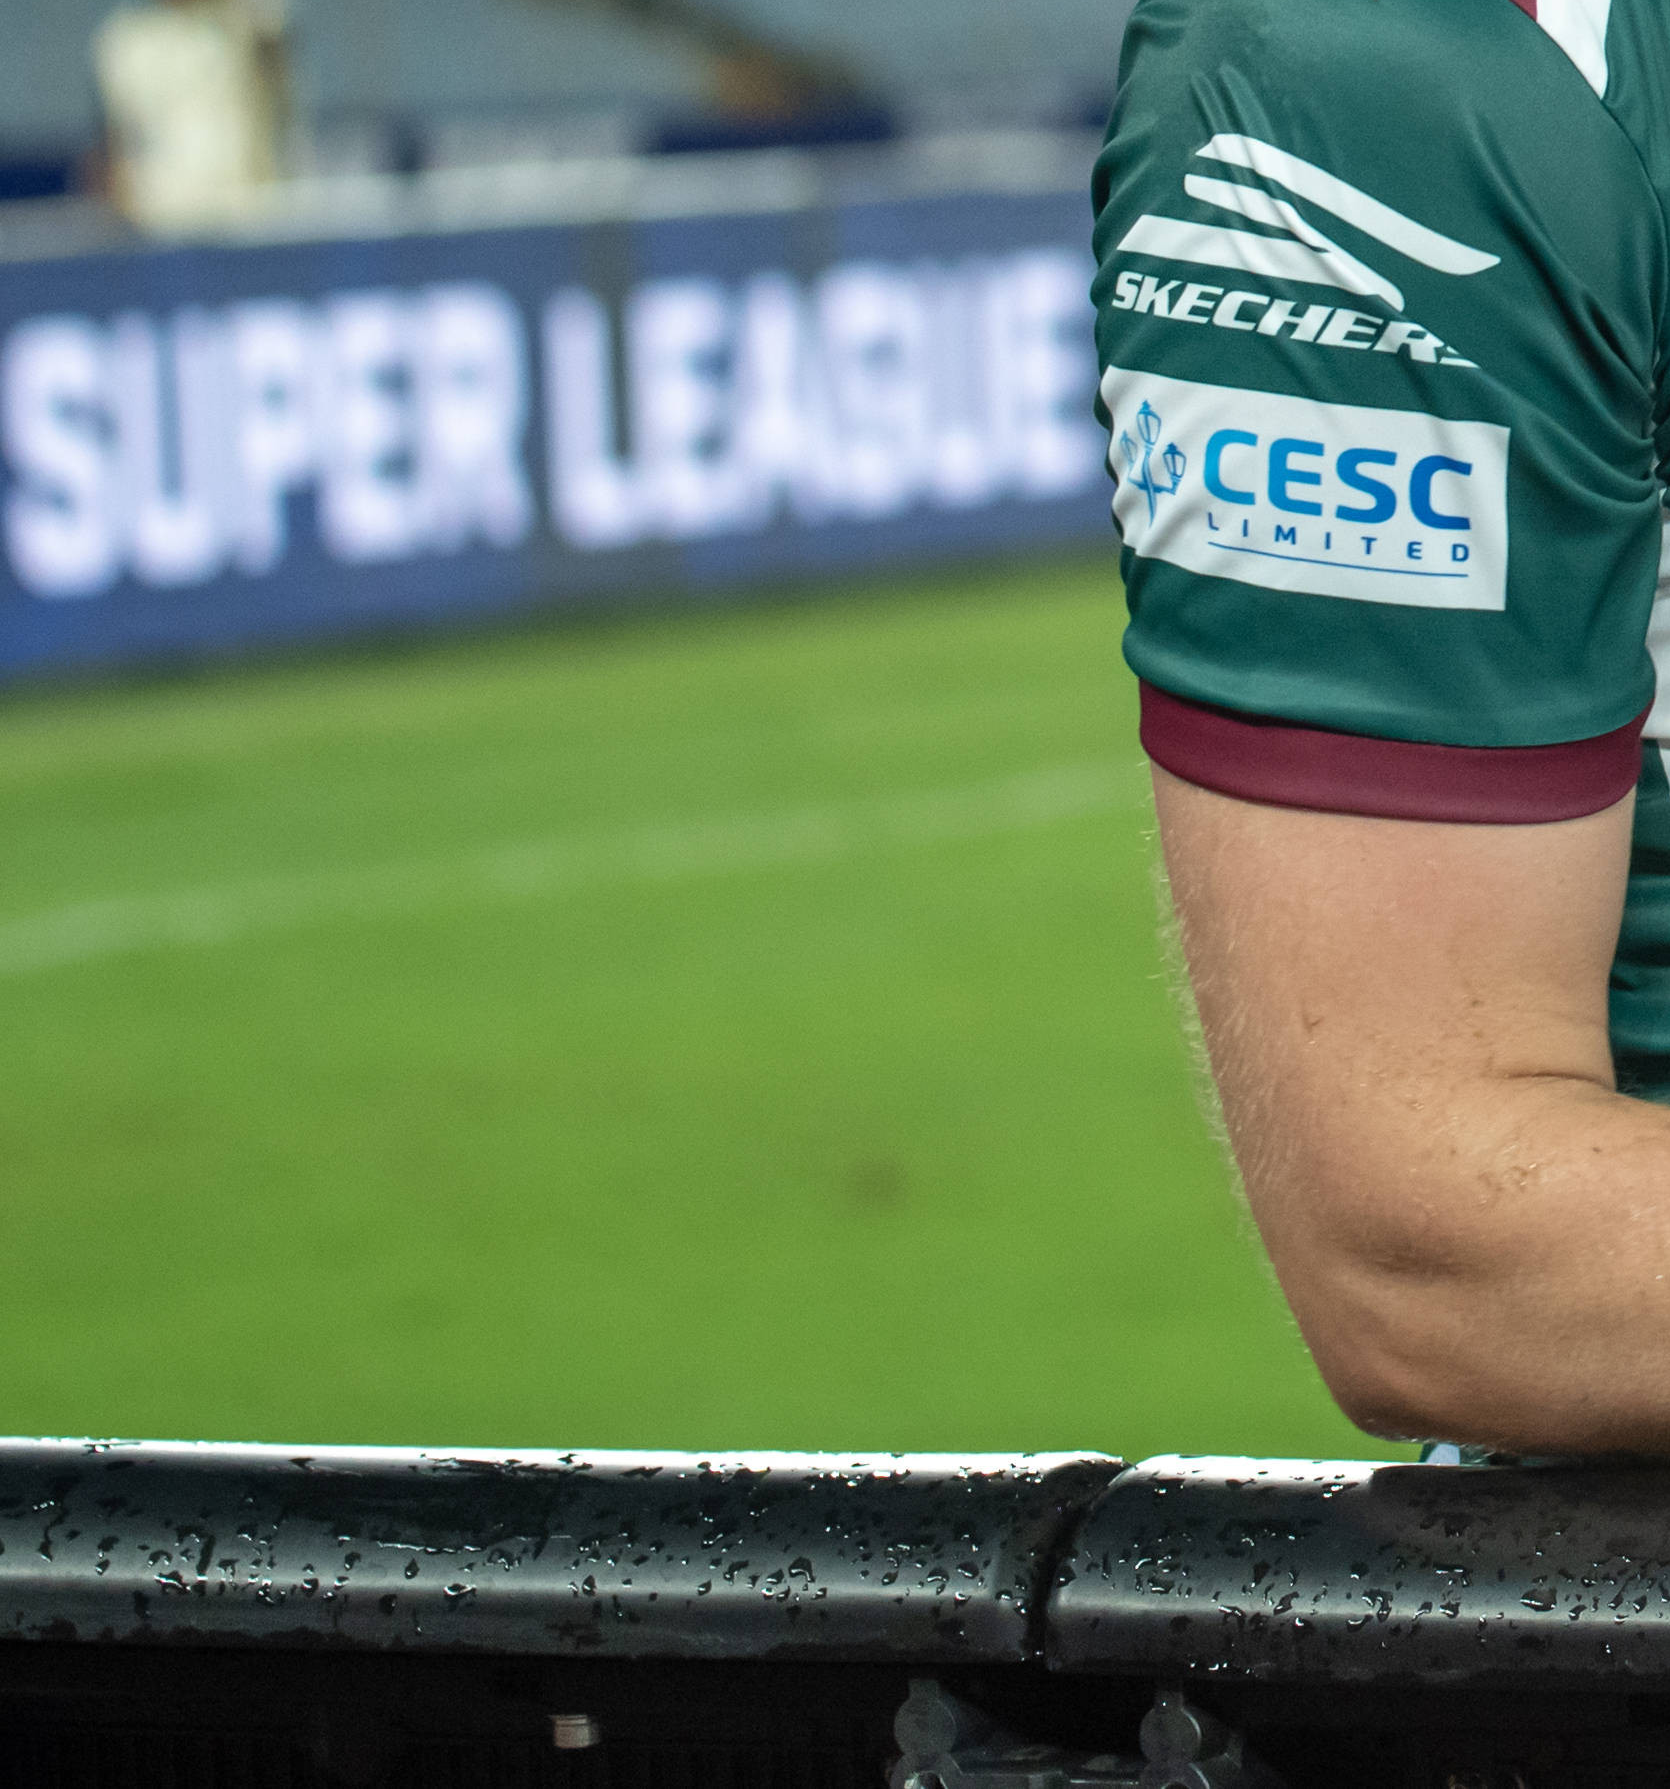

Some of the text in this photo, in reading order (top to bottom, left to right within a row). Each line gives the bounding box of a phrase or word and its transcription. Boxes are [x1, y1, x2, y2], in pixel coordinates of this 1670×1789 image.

[4, 247, 1094, 600] SUPER LEAGUE
[1203, 429, 1473, 531] CESC
[1207, 511, 1470, 563] LIMITED
